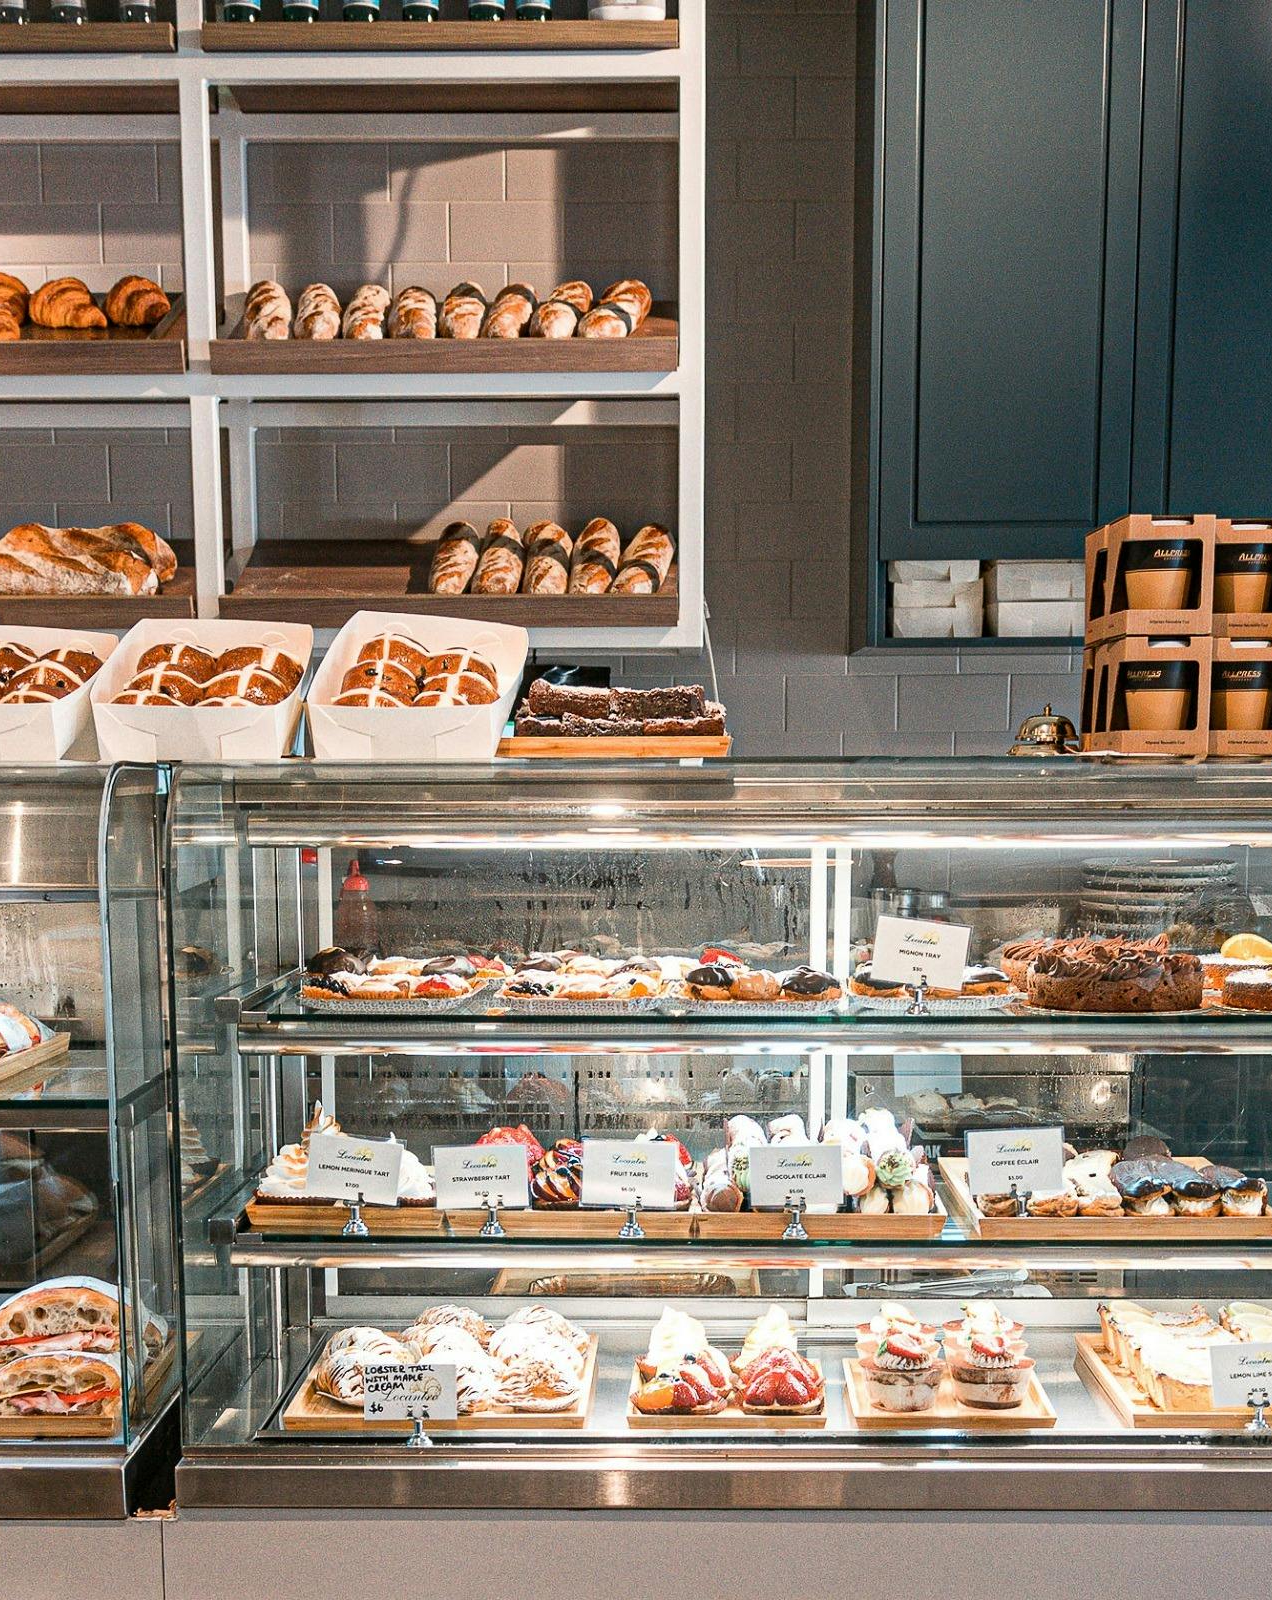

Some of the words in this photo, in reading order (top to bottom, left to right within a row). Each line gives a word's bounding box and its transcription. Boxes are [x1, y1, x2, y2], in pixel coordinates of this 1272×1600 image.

[899, 949, 923, 957] MIGNON
[996, 1144, 1031, 1153] Locantro
[337, 1148, 372, 1162] Locantro
[612, 1154, 647, 1164] Locantro
[462, 1159, 497, 1169] Locantro
[777, 1158, 812, 1168] Locantro
[318, 1163, 340, 1171] LEMON
[341, 1166, 373, 1175] MERINGUE
[374, 1170, 390, 1178] TART
[1238, 1356, 1272, 1366] Locantro
[365, 1365, 406, 1375] LOBSTER
[365, 1374, 389, 1384] WITH
[393, 1373, 424, 1382] MAPLE
[367, 1382, 405, 1392] CREAM
[382, 1387, 439, 1401] Locantro
[368, 1401, 384, 1414] $6
